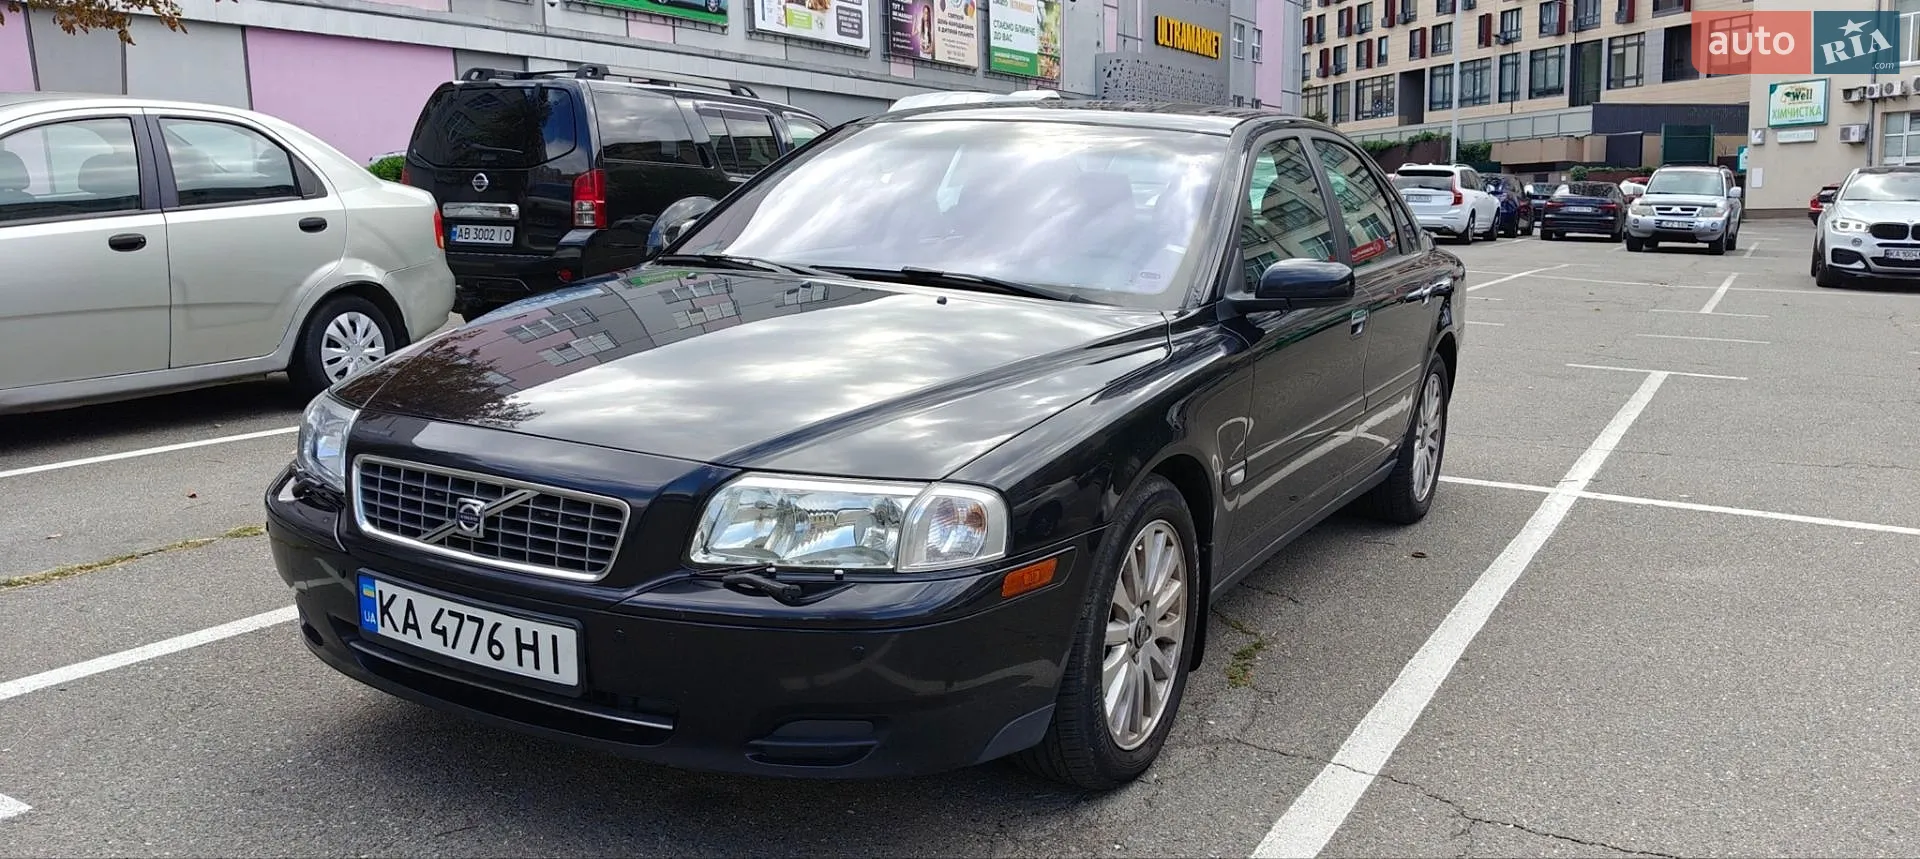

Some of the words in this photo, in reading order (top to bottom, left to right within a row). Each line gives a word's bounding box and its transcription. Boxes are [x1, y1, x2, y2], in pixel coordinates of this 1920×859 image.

[1156, 15, 1222, 59] ULTRAMARKET
[1791, 88, 1813, 101] Well
[1771, 104, 1822, 120] ХІМЧИСТКА
[458, 227, 471, 240] AB
[472, 228, 495, 241] 3002
[499, 229, 512, 242] IO
[364, 612, 376, 625] UA
[378, 589, 423, 640] KA
[430, 607, 505, 661] 4776
[515, 627, 560, 675] HI
